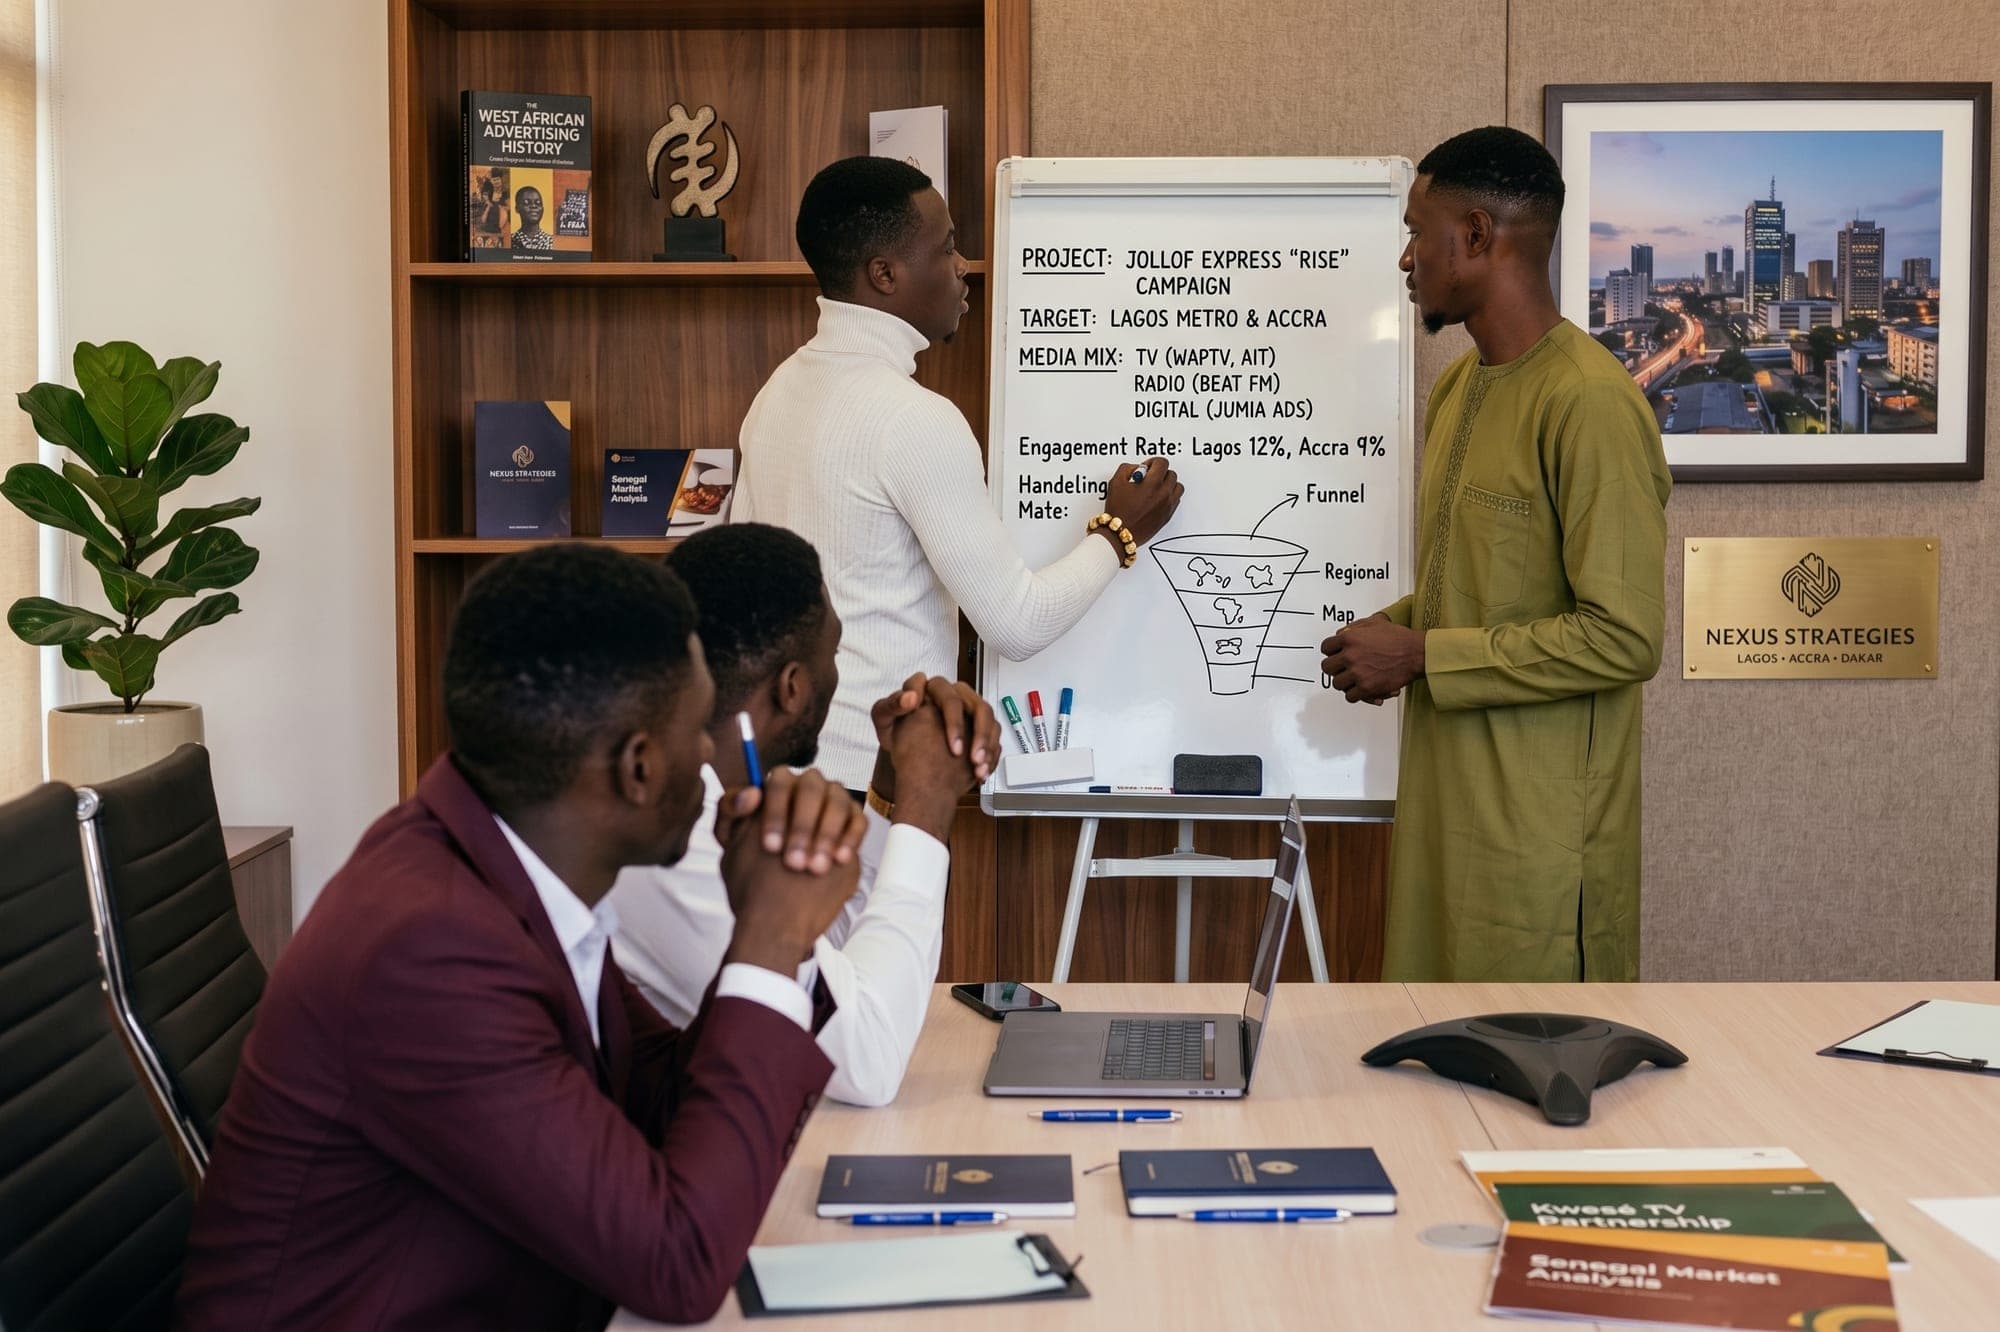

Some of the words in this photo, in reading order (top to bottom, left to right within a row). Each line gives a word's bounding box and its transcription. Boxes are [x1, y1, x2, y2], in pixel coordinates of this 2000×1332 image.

[479, 109, 520, 124] WEST
[522, 111, 585, 127] AFRICAN
[483, 124, 580, 142] ADVERTISING
[501, 140, 564, 155] HISTORY
[1022, 248, 1112, 268] PROJECT:
[1126, 250, 1195, 269] JOLLOF
[1201, 250, 1282, 269] EXPRESS
[1136, 276, 1231, 295] CAMPAIGN
[1020, 308, 1097, 328] TARGET:
[1111, 308, 1169, 328] LAGOS
[1177, 308, 1238, 328] METRO
[1247, 308, 1260, 328] &
[1266, 308, 1327, 328] ACCRA
[1019, 347, 1077, 367] MEDIA
[1084, 347, 1123, 367] MIX:
[1136, 348, 1159, 366] TV
[1165, 346, 1235, 368] (WAPTV,
[1241, 346, 1276, 368] AIT)
[1134, 374, 1185, 393] RADIO
[1192, 373, 1243, 395] (BEAT
[1250, 373, 1280, 395] FM)
[1134, 400, 1199, 419] DIGITAL
[1207, 399, 1266, 420] (JUMIA
[1273, 398, 1313, 420] ADS)
[1019, 436, 1128, 462] Engagement
[1136, 436, 1182, 457] Rate:
[1192, 436, 1242, 462] Lagos
[1249, 436, 1292, 459] 12%,
[1299, 436, 1349, 457] Accra
[1357, 436, 1386, 457] 9%
[611, 474, 648, 485] Senegal
[1019, 474, 1107, 500] Handeling
[1306, 483, 1365, 503] Funnel
[1019, 500, 1068, 520] Mate:
[1325, 561, 1389, 585] Regional
[1322, 604, 1355, 625] Map
[1706, 628, 1778, 645] NEXUS
[1784, 627, 1915, 645] STRATEGIES
[1737, 653, 1778, 664] LAGOS
[1789, 653, 1830, 664] ACCRA
[1841, 653, 1883, 664] DAKAR
[1530, 1203, 1637, 1216] Kwesé
[1642, 1203, 1686, 1216] TV
[1537, 1215, 1733, 1231] Partnership
[1526, 1268, 1663, 1291] Analysis
[1529, 1254, 1657, 1277] Senegal
[1666, 1264, 1782, 1286] Market
